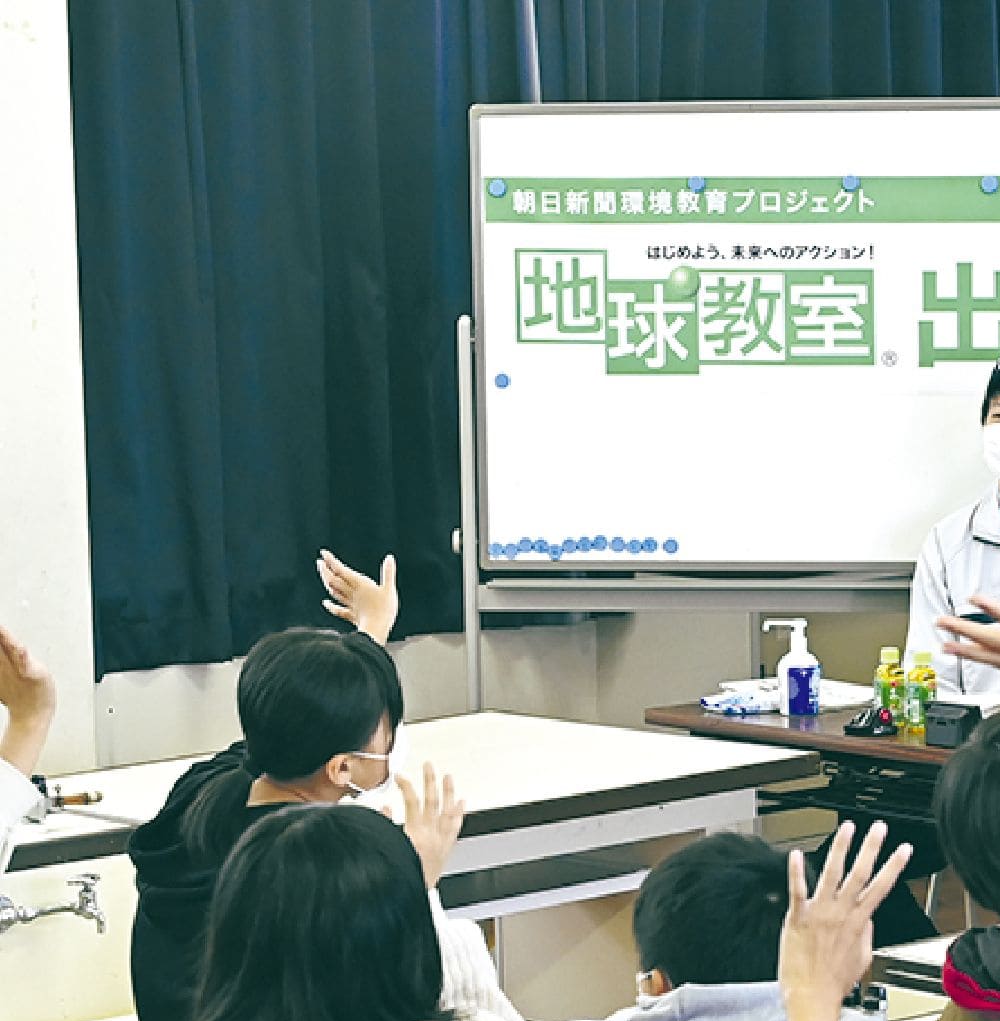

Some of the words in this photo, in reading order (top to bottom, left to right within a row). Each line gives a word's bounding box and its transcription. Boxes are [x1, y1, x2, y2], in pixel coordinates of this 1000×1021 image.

[512, 188, 875, 215] 朝日新聞環境教育プロジェクト
[521, 256, 872, 369] 地球教室
